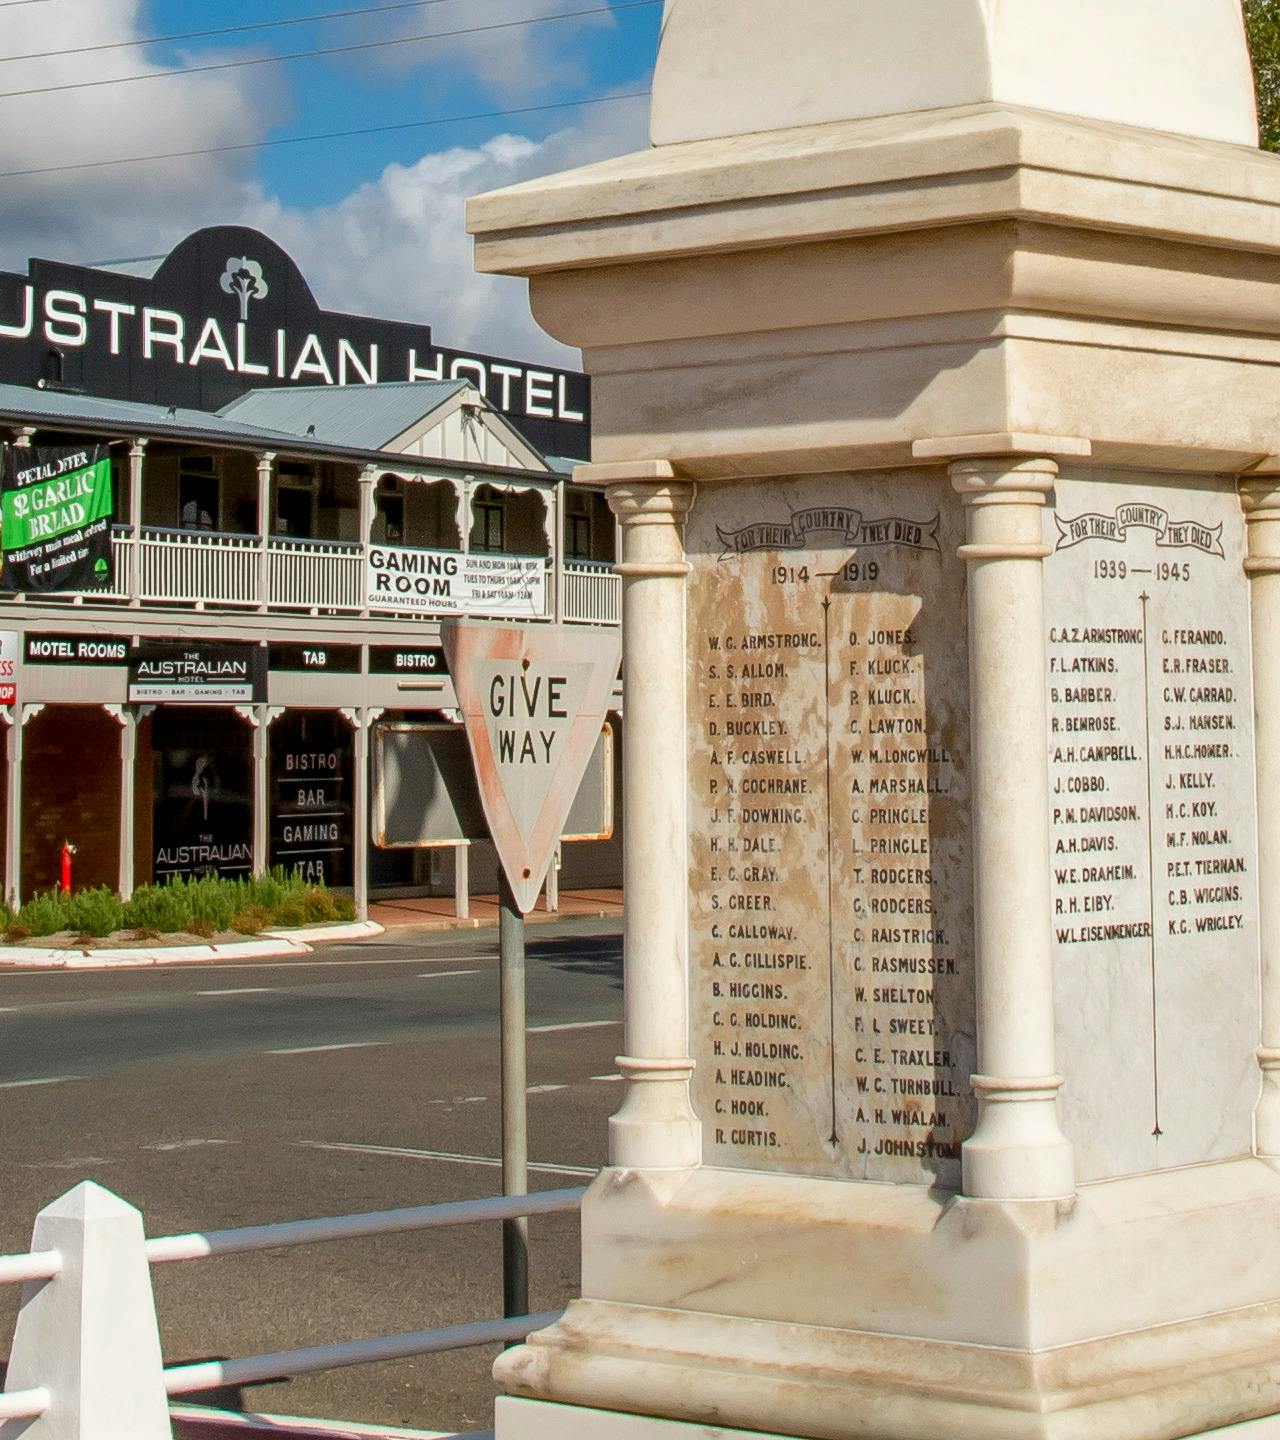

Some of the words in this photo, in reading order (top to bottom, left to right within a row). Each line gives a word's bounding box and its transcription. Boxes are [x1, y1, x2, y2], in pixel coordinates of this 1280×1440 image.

[408, 348, 584, 421] HOTEL
[31, 470, 96, 511] GARLIC
[734, 533, 755, 551] FOR
[759, 527, 791, 545] THEIR
[797, 510, 854, 530] COUNTRY
[861, 524, 890, 544] THEY
[893, 525, 921, 543] DIED
[1069, 523, 1087, 541] FOR
[1090, 520, 1116, 537] THEIR
[1120, 508, 1163, 528] COUNTRY
[1168, 527, 1190, 544] THEY
[1191, 528, 1212, 549] DIED
[369, 550, 458, 576] GAMING
[1093, 560, 1127, 579] 1939
[1156, 562, 1190, 582] 1945
[771, 566, 809, 584] 1914
[843, 562, 879, 582] 1919
[376, 573, 451, 597] ROOM
[368, 595, 426, 606] GUARANTEED
[428, 600, 458, 609] HOURS
[868, 630, 917, 645] JONES.
[30, 642, 75, 657] MOTEL
[78, 643, 126, 659] ROOMS
[303, 651, 326, 665] TAB
[138, 661, 246, 674] AUSTRALIAN
[396, 654, 436, 668] BISTRO
[868, 659, 914, 675] KLUCK.
[741, 663, 788, 679] ALLOM.
[490, 674, 568, 718] GIVE
[741, 692, 775, 708] BIRD.
[868, 689, 916, 705] KLUCK.
[1065, 688, 1116, 703] BARBER.
[726, 721, 788, 736] BUCKLEY.
[869, 719, 927, 734] LAWTON.
[499, 730, 556, 764] WAY
[286, 753, 337, 770] BISTRO
[742, 750, 807, 765] CASWELL.
[742, 779, 812, 794] COCHRANE.
[870, 778, 948, 794] MARSHALL.
[1180, 773, 1215, 789] KELLY.
[298, 789, 325, 806] BAR
[283, 824, 338, 843] GAMING
[156, 843, 253, 863] AUSTRALIAN
[743, 838, 781, 854] DALE.
[297, 860, 324, 877] TAB
[872, 956, 960, 975] RASMUSSEN.
[873, 987, 938, 1004] SHELTON.
[890, 1018, 938, 1036] SWEET.
[891, 1049, 956, 1068] TRAXLER.
[891, 1078, 961, 1097] TURNBULL.
[731, 1100, 769, 1116] HOOK.
[731, 1129, 781, 1148] CURTIS.
